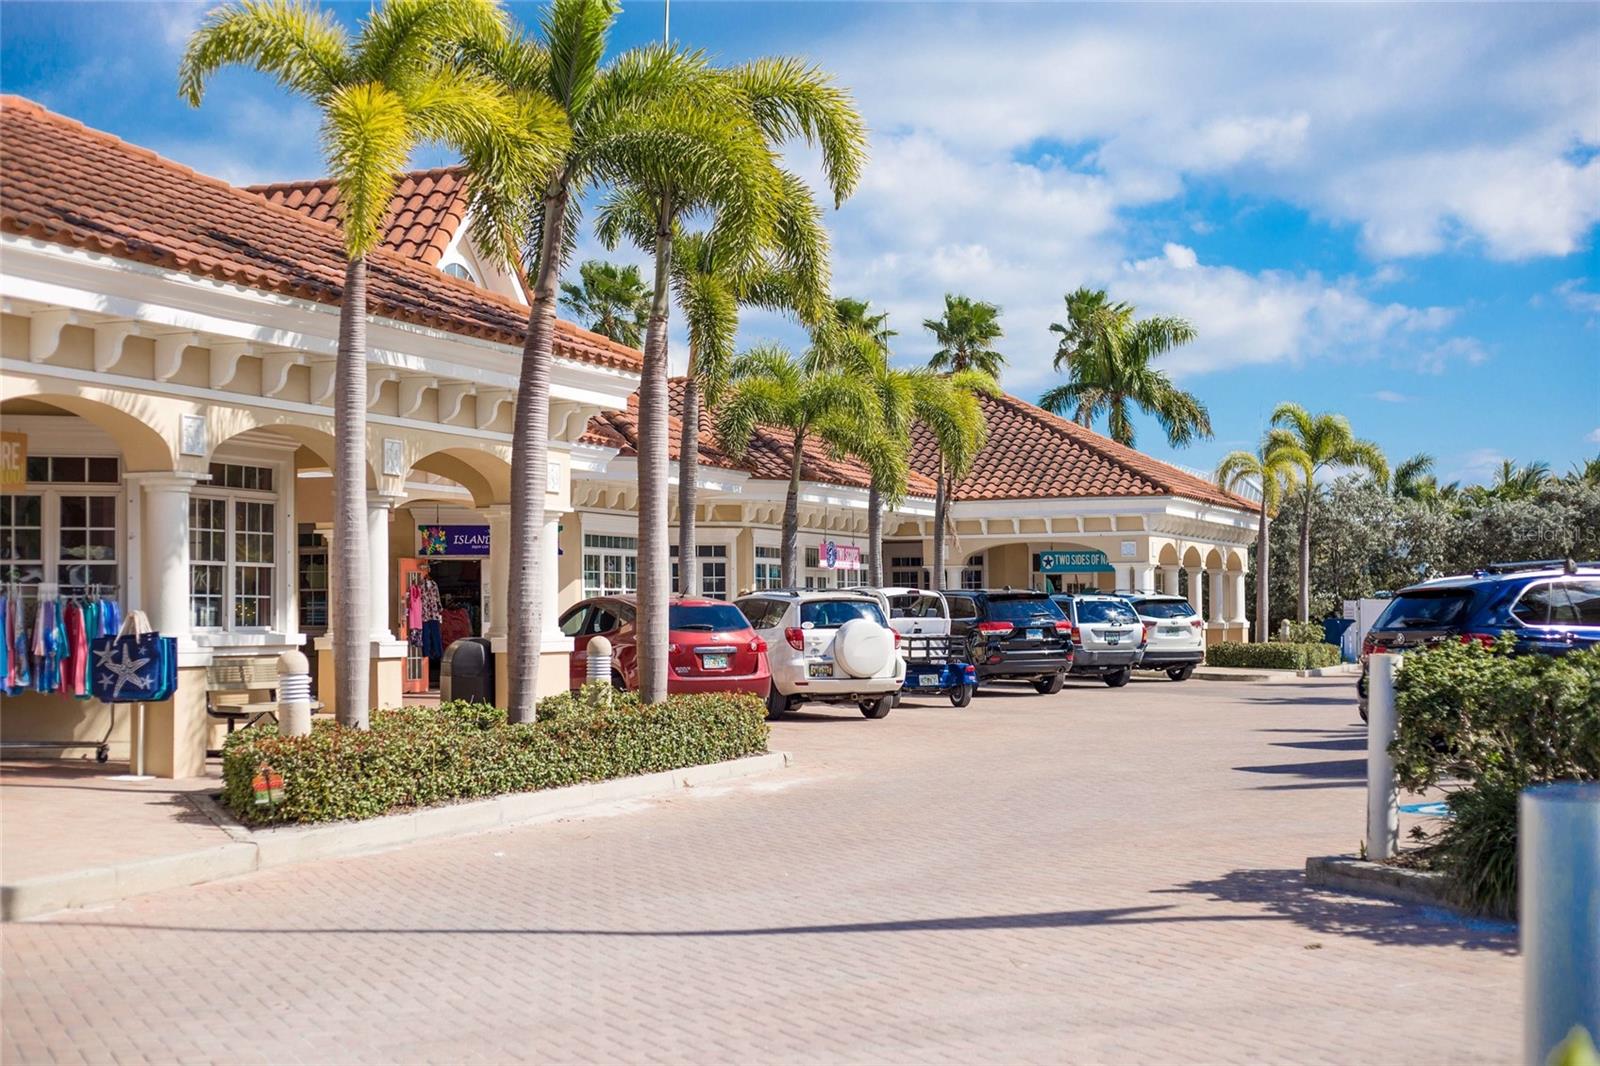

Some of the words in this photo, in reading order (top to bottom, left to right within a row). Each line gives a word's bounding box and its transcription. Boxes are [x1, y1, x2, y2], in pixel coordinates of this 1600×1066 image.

[1055, 554, 1070, 566] TWO
[1071, 554, 1090, 566] SIDES
[1091, 554, 1100, 566] OF
